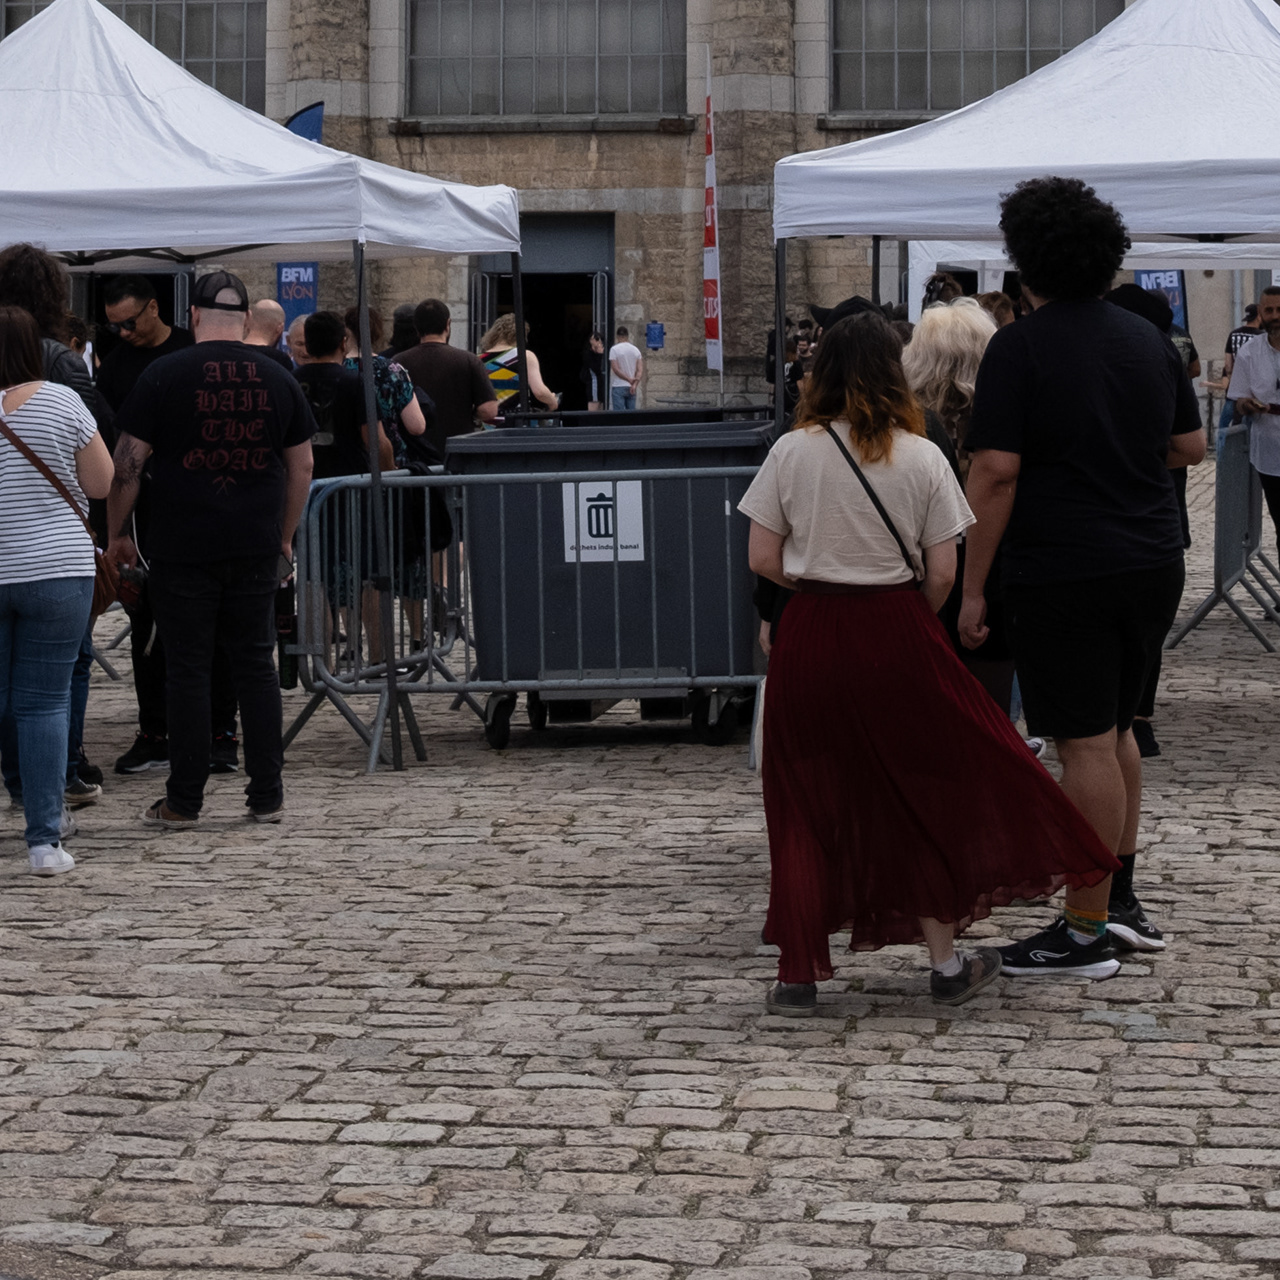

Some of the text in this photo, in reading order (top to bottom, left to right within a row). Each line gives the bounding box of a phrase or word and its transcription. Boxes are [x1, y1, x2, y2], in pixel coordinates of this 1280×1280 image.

[281, 267, 313, 282] BFM
[282, 282, 314, 300] LYON
[203, 361, 262, 382] ALL
[194, 389, 272, 413] HAIL
[201, 418, 265, 445] THE
[182, 447, 271, 471] GOAT
